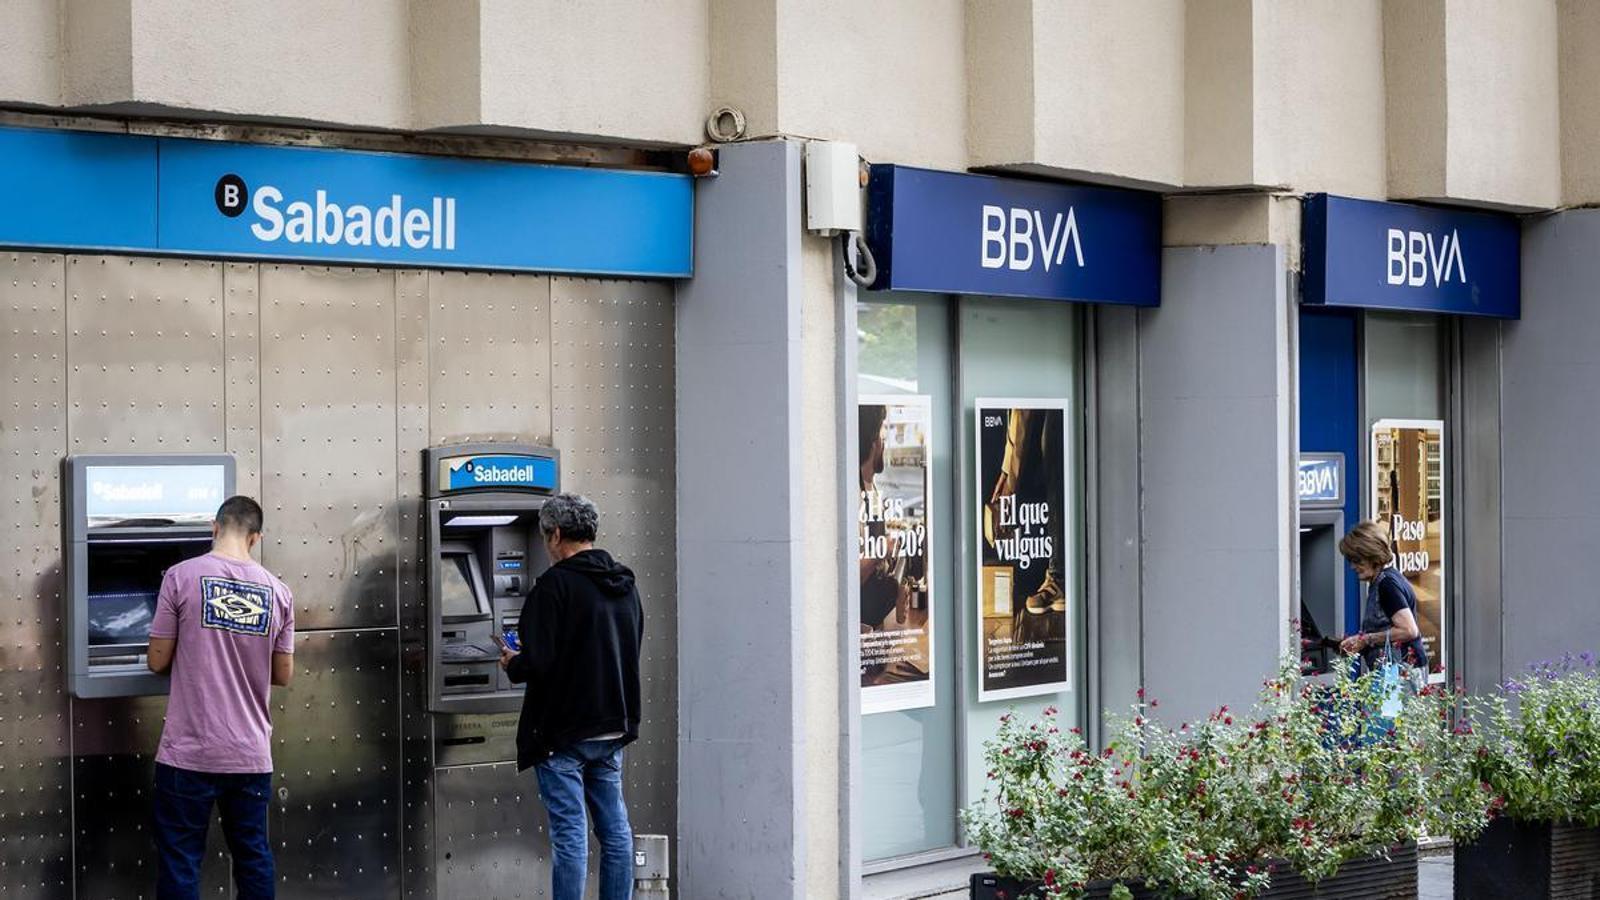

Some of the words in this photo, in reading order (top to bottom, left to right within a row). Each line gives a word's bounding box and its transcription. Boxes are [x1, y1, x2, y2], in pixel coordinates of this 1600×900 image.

[250, 185, 456, 251] Sabadell
[981, 204, 1085, 273] BBVA
[1387, 228, 1466, 289] BBVA
[984, 415, 1003, 427] BBVA
[473, 464, 534, 483] Sabadell
[1299, 466, 1333, 496] BBVA
[999, 494, 1017, 526] El
[1019, 502, 1049, 534] que
[1393, 513, 1425, 541] Paso
[890, 524, 926, 558] 720?
[995, 527, 1053, 569] vulguis
[1399, 551, 1429, 575] paso
